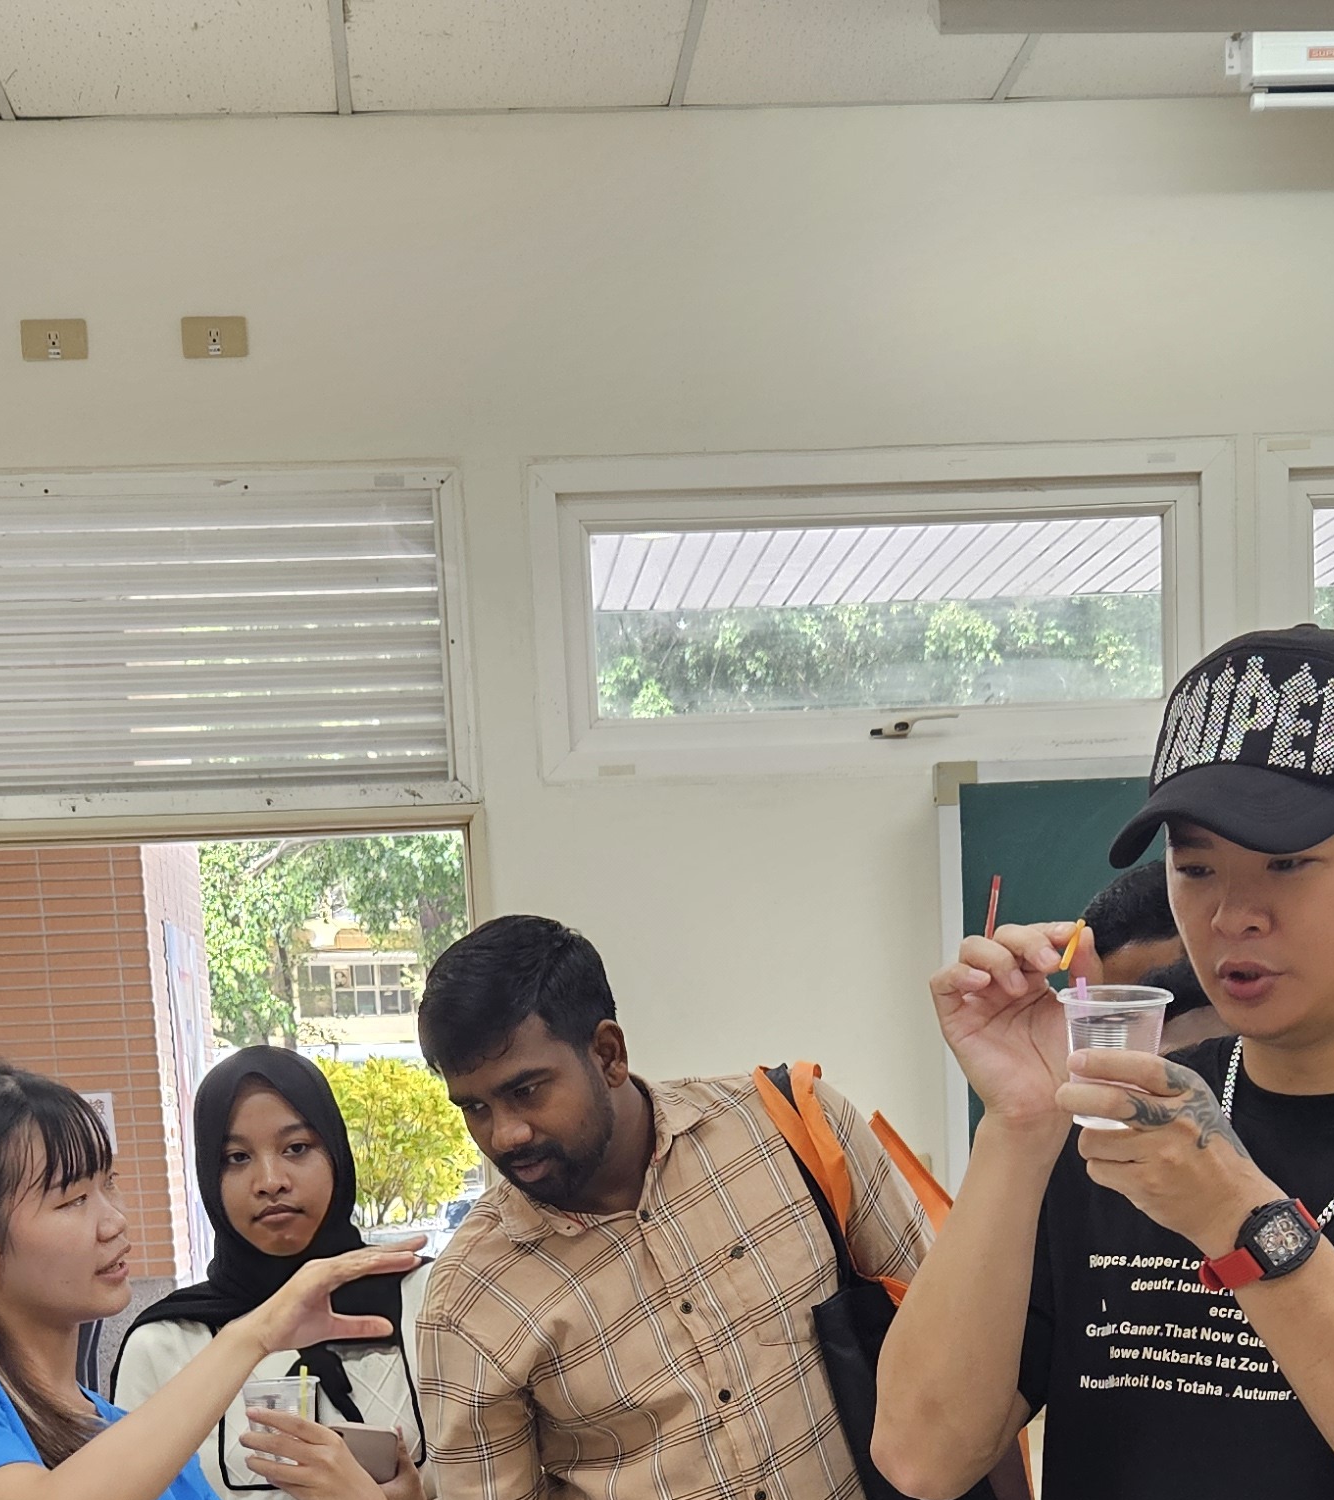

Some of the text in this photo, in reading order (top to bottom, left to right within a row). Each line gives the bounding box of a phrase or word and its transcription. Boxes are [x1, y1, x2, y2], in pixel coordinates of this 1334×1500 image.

[1200, 1327, 1234, 1343] Now
[1141, 1346, 1212, 1367] Nukbarks
[1237, 1357, 1268, 1373] Zou
